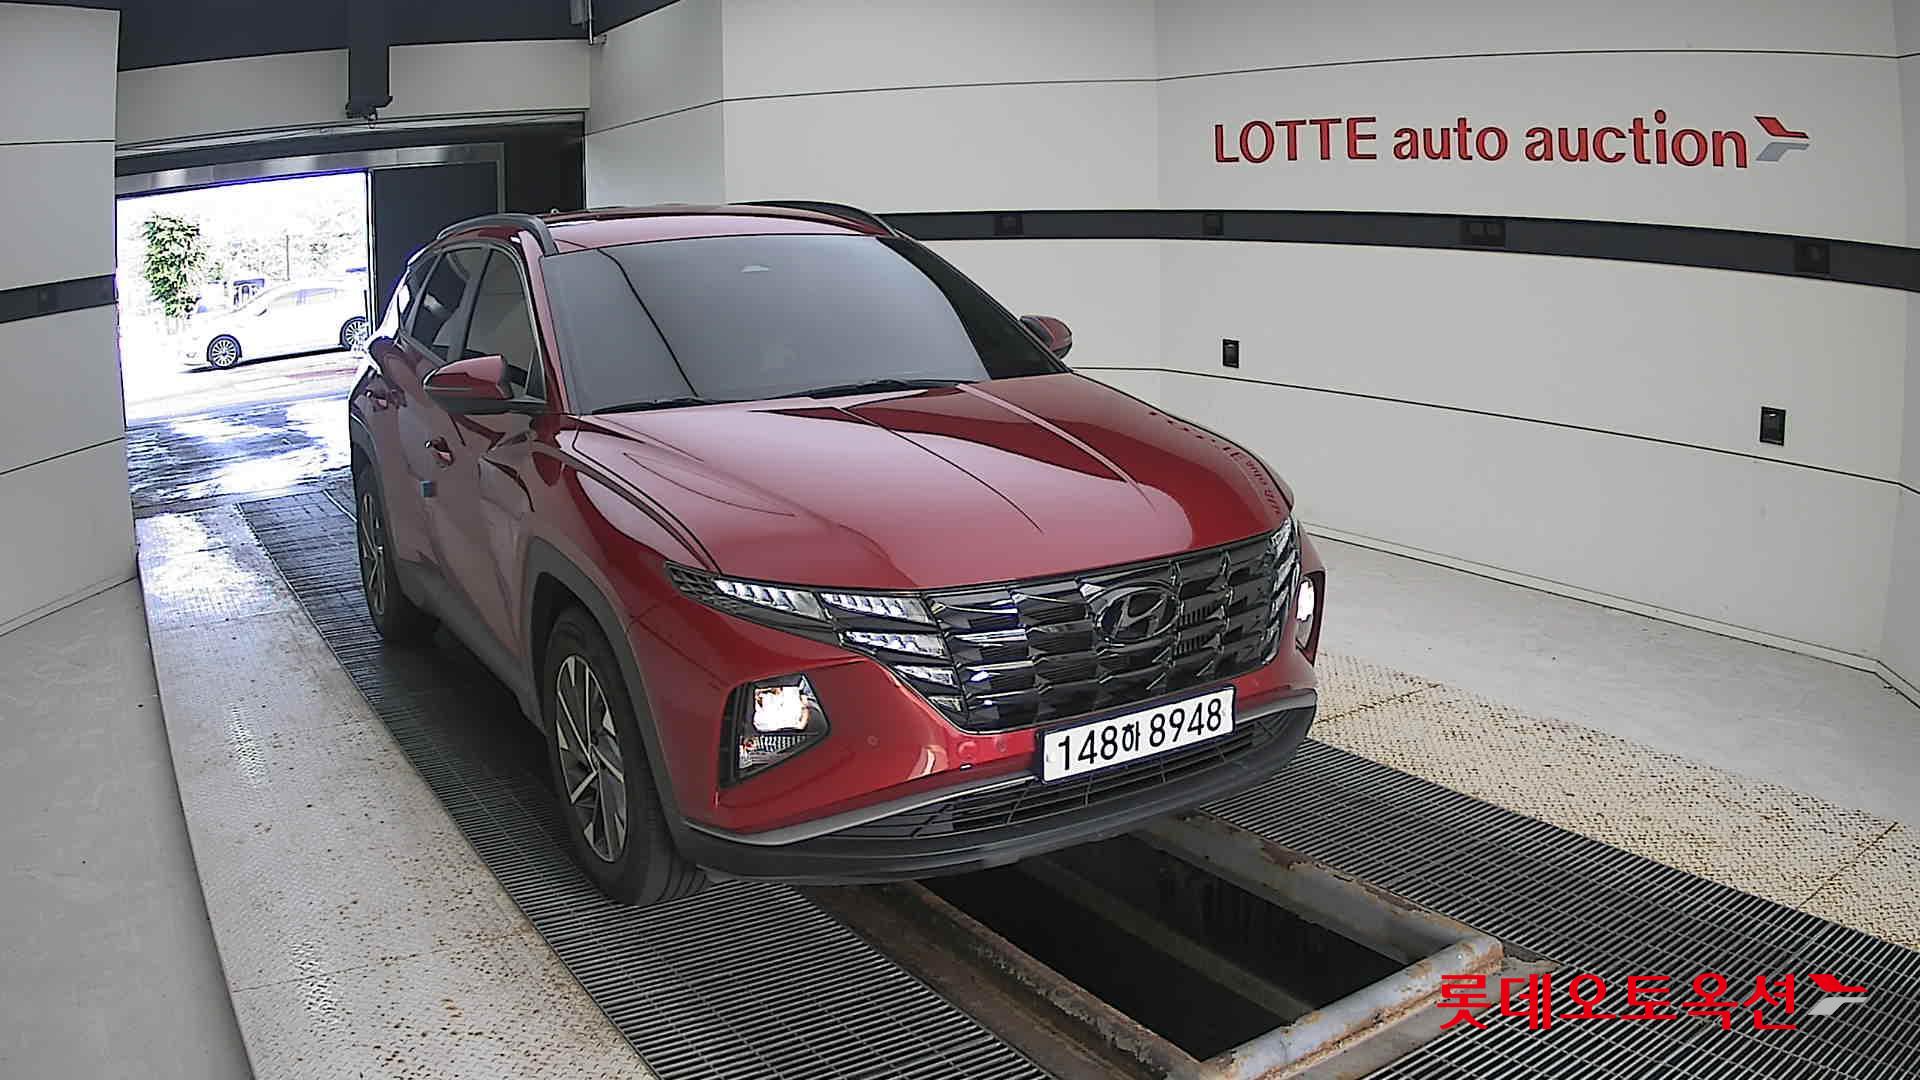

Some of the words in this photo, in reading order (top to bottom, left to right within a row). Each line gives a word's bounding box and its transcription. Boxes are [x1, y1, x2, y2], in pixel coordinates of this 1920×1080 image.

[1214, 116, 1378, 163] LOTTE
[1392, 117, 1509, 162] auto
[1524, 109, 1748, 169] auction
[1058, 721, 1141, 771] 148하
[1149, 698, 1222, 748] 8948
